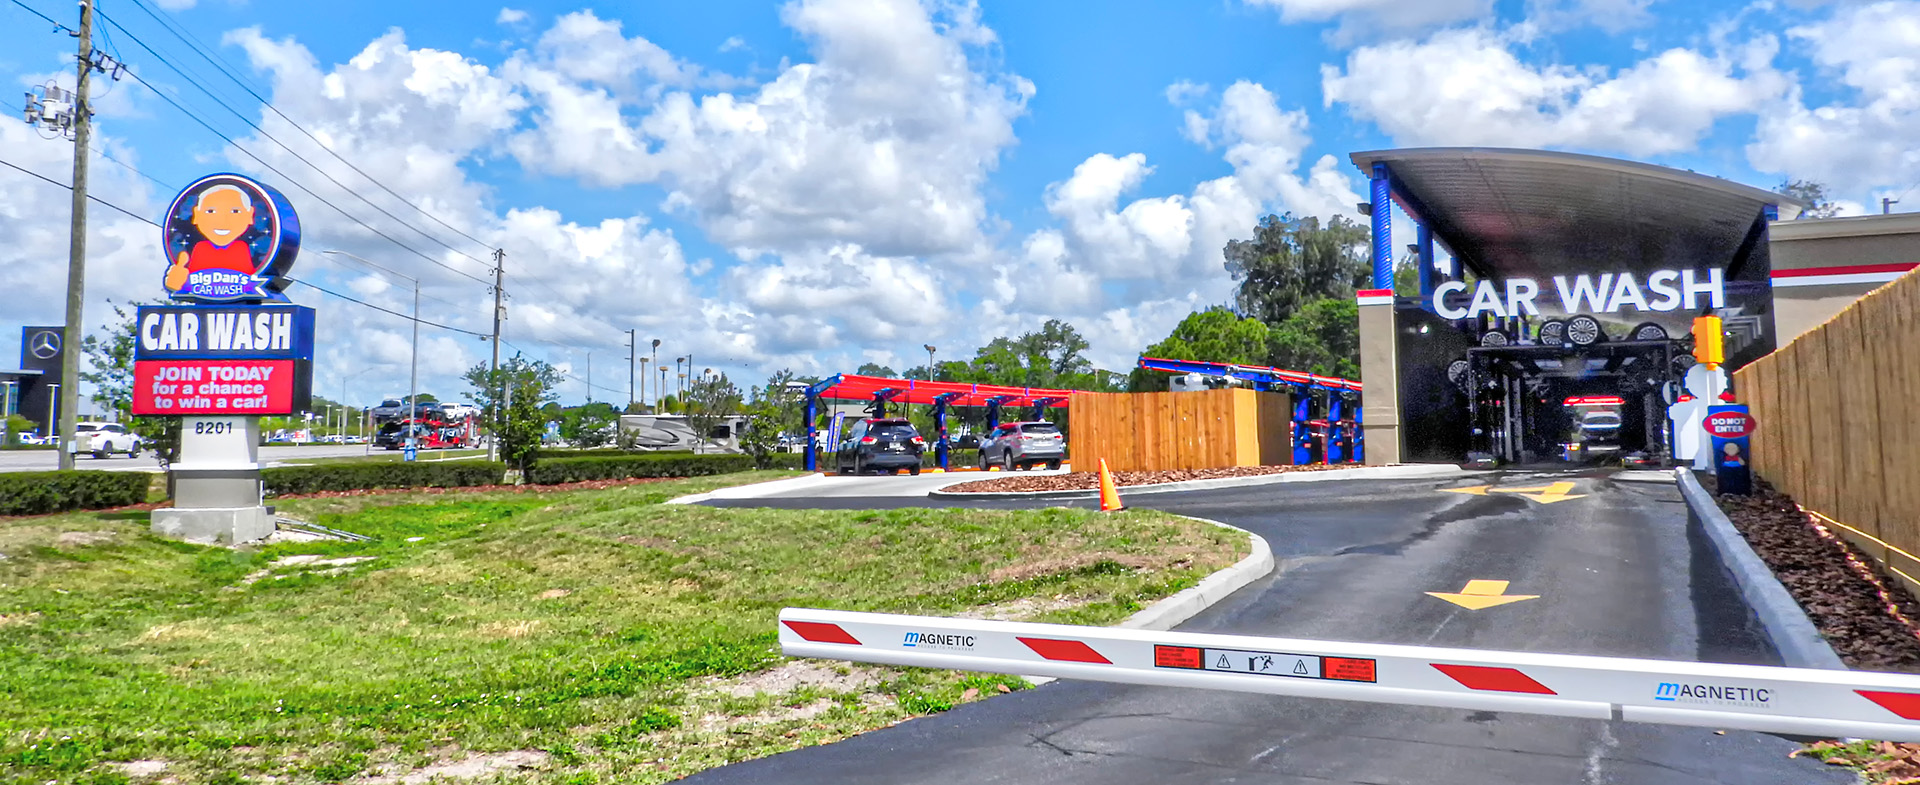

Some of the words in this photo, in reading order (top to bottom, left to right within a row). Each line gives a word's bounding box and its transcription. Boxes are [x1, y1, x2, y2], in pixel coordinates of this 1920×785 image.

[189, 272, 212, 286] Big
[212, 272, 249, 286] Dan's
[193, 284, 213, 295] CAR
[213, 284, 244, 295] WASH
[1432, 277, 1540, 320] CAR
[1552, 267, 1725, 315] WASH
[141, 312, 200, 351] CAR
[206, 312, 293, 351] WASH
[153, 366, 202, 382] JOIN
[207, 366, 275, 382] TODAY
[151, 381, 178, 395] for
[182, 383, 194, 395] a
[198, 381, 265, 395] chance
[154, 396, 174, 409] to
[178, 395, 211, 409] win
[216, 397, 228, 409] a
[232, 395, 268, 409] car!
[195, 421, 233, 435] 8201
[1711, 417, 1726, 426] DO
[1726, 417, 1746, 426] NOT
[1714, 425, 1744, 434] ENTER
